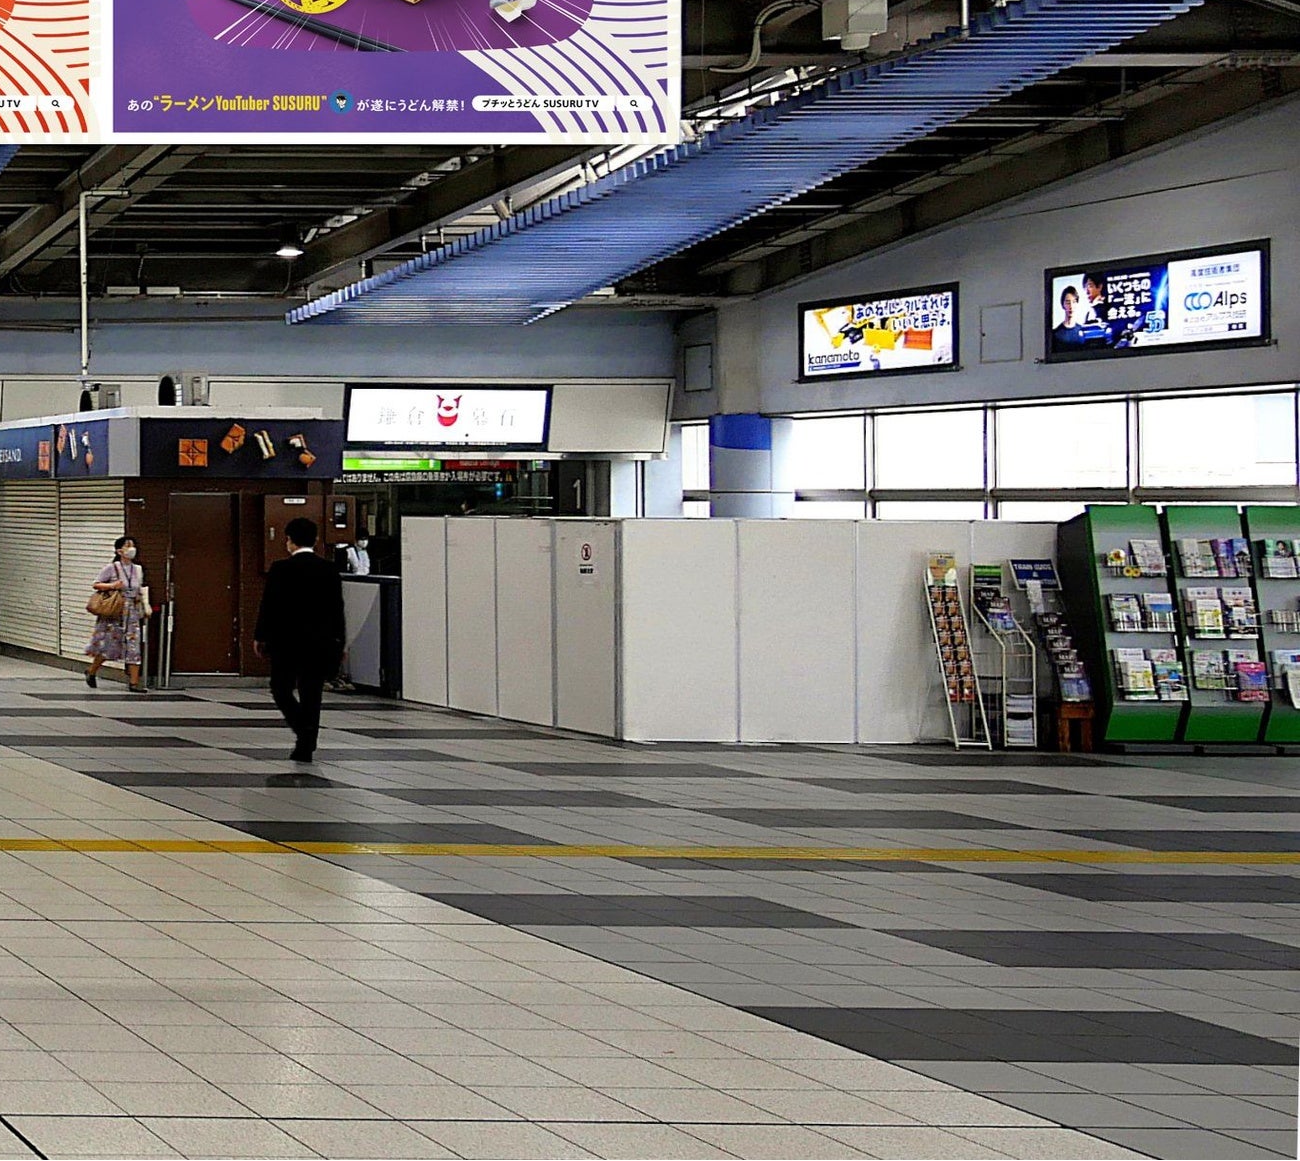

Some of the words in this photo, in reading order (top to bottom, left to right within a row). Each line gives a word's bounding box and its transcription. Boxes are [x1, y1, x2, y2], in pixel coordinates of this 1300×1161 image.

[7, 99, 21, 109] TV
[357, 99, 465, 112] が遂にうどん解禁!
[482, 99, 540, 109] プチッとうどん
[544, 99, 582, 109] SUSURU
[585, 99, 599, 109] TV
[1107, 279, 1151, 292] いくつもの
[1213, 291, 1247, 308] Alps
[809, 350, 859, 364] kanamoto
